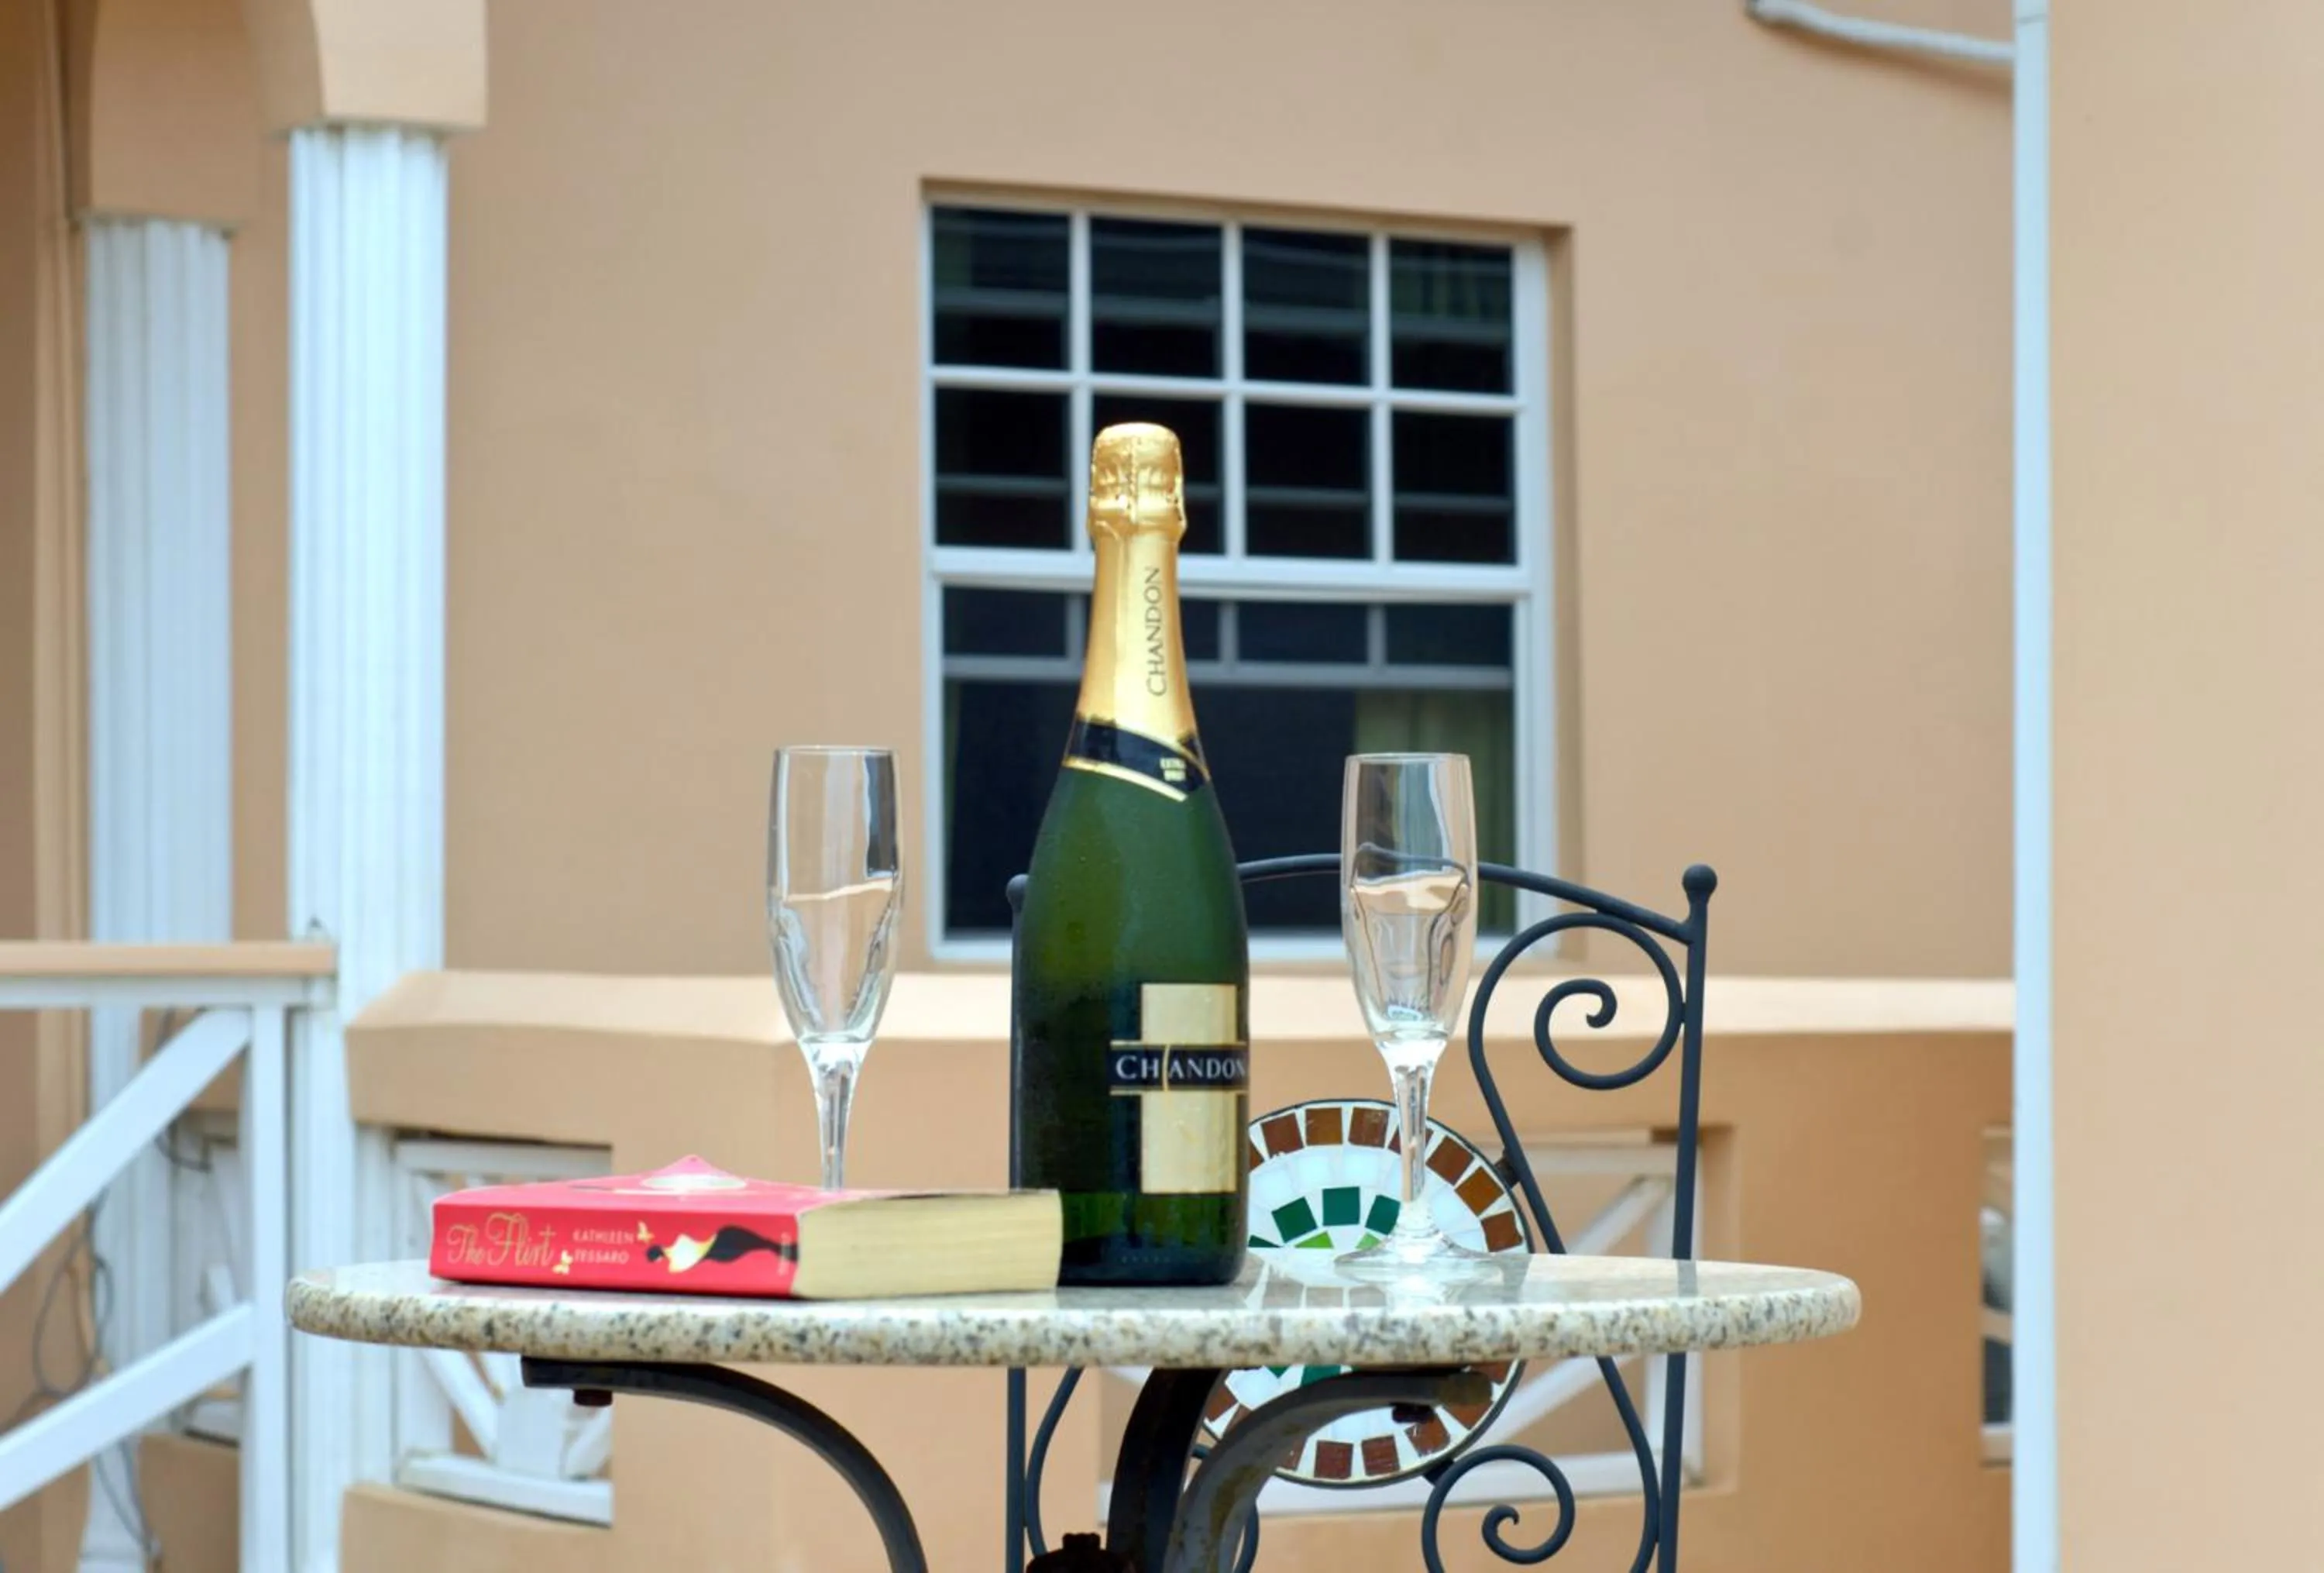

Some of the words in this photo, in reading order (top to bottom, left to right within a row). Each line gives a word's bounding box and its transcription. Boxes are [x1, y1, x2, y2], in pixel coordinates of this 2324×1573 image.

[1143, 566, 1167, 697] CHANDON
[1116, 1055, 1246, 1080] CHANDON
[446, 1224, 486, 1265] The
[485, 1211, 558, 1267] Flirt
[572, 1228, 635, 1245] KATHLEEN
